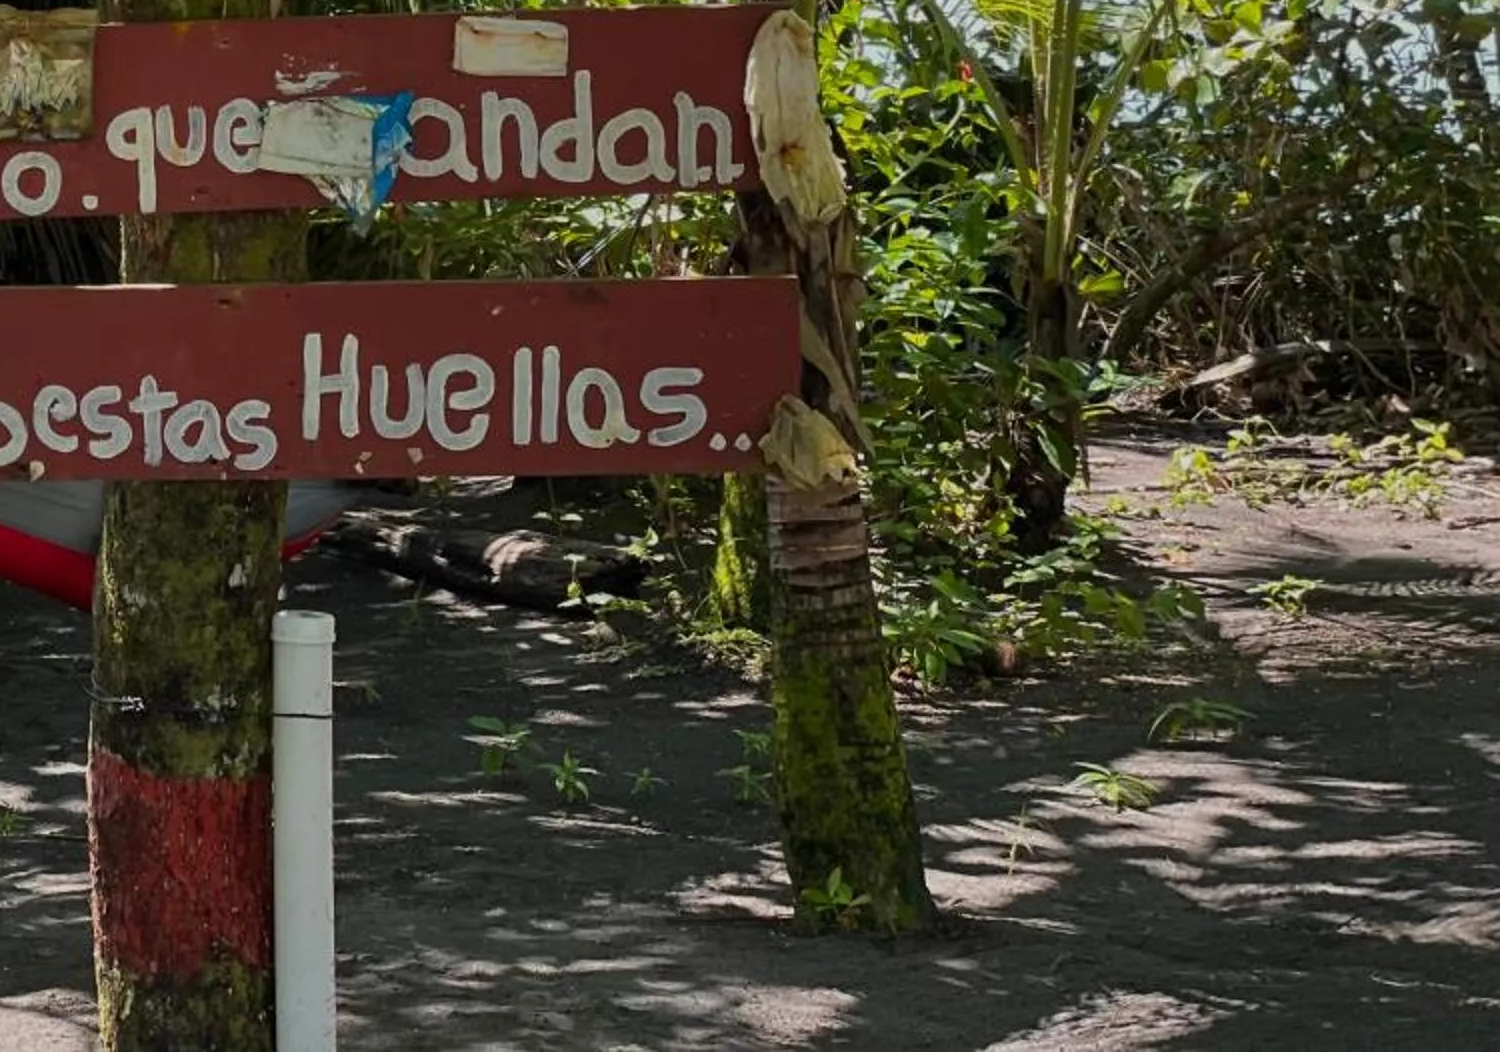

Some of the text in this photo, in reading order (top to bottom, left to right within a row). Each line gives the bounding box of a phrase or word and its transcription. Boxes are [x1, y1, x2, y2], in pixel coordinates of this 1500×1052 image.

[105, 97, 262, 214] que
[401, 69, 744, 188] andan
[32, 375, 278, 471] estas
